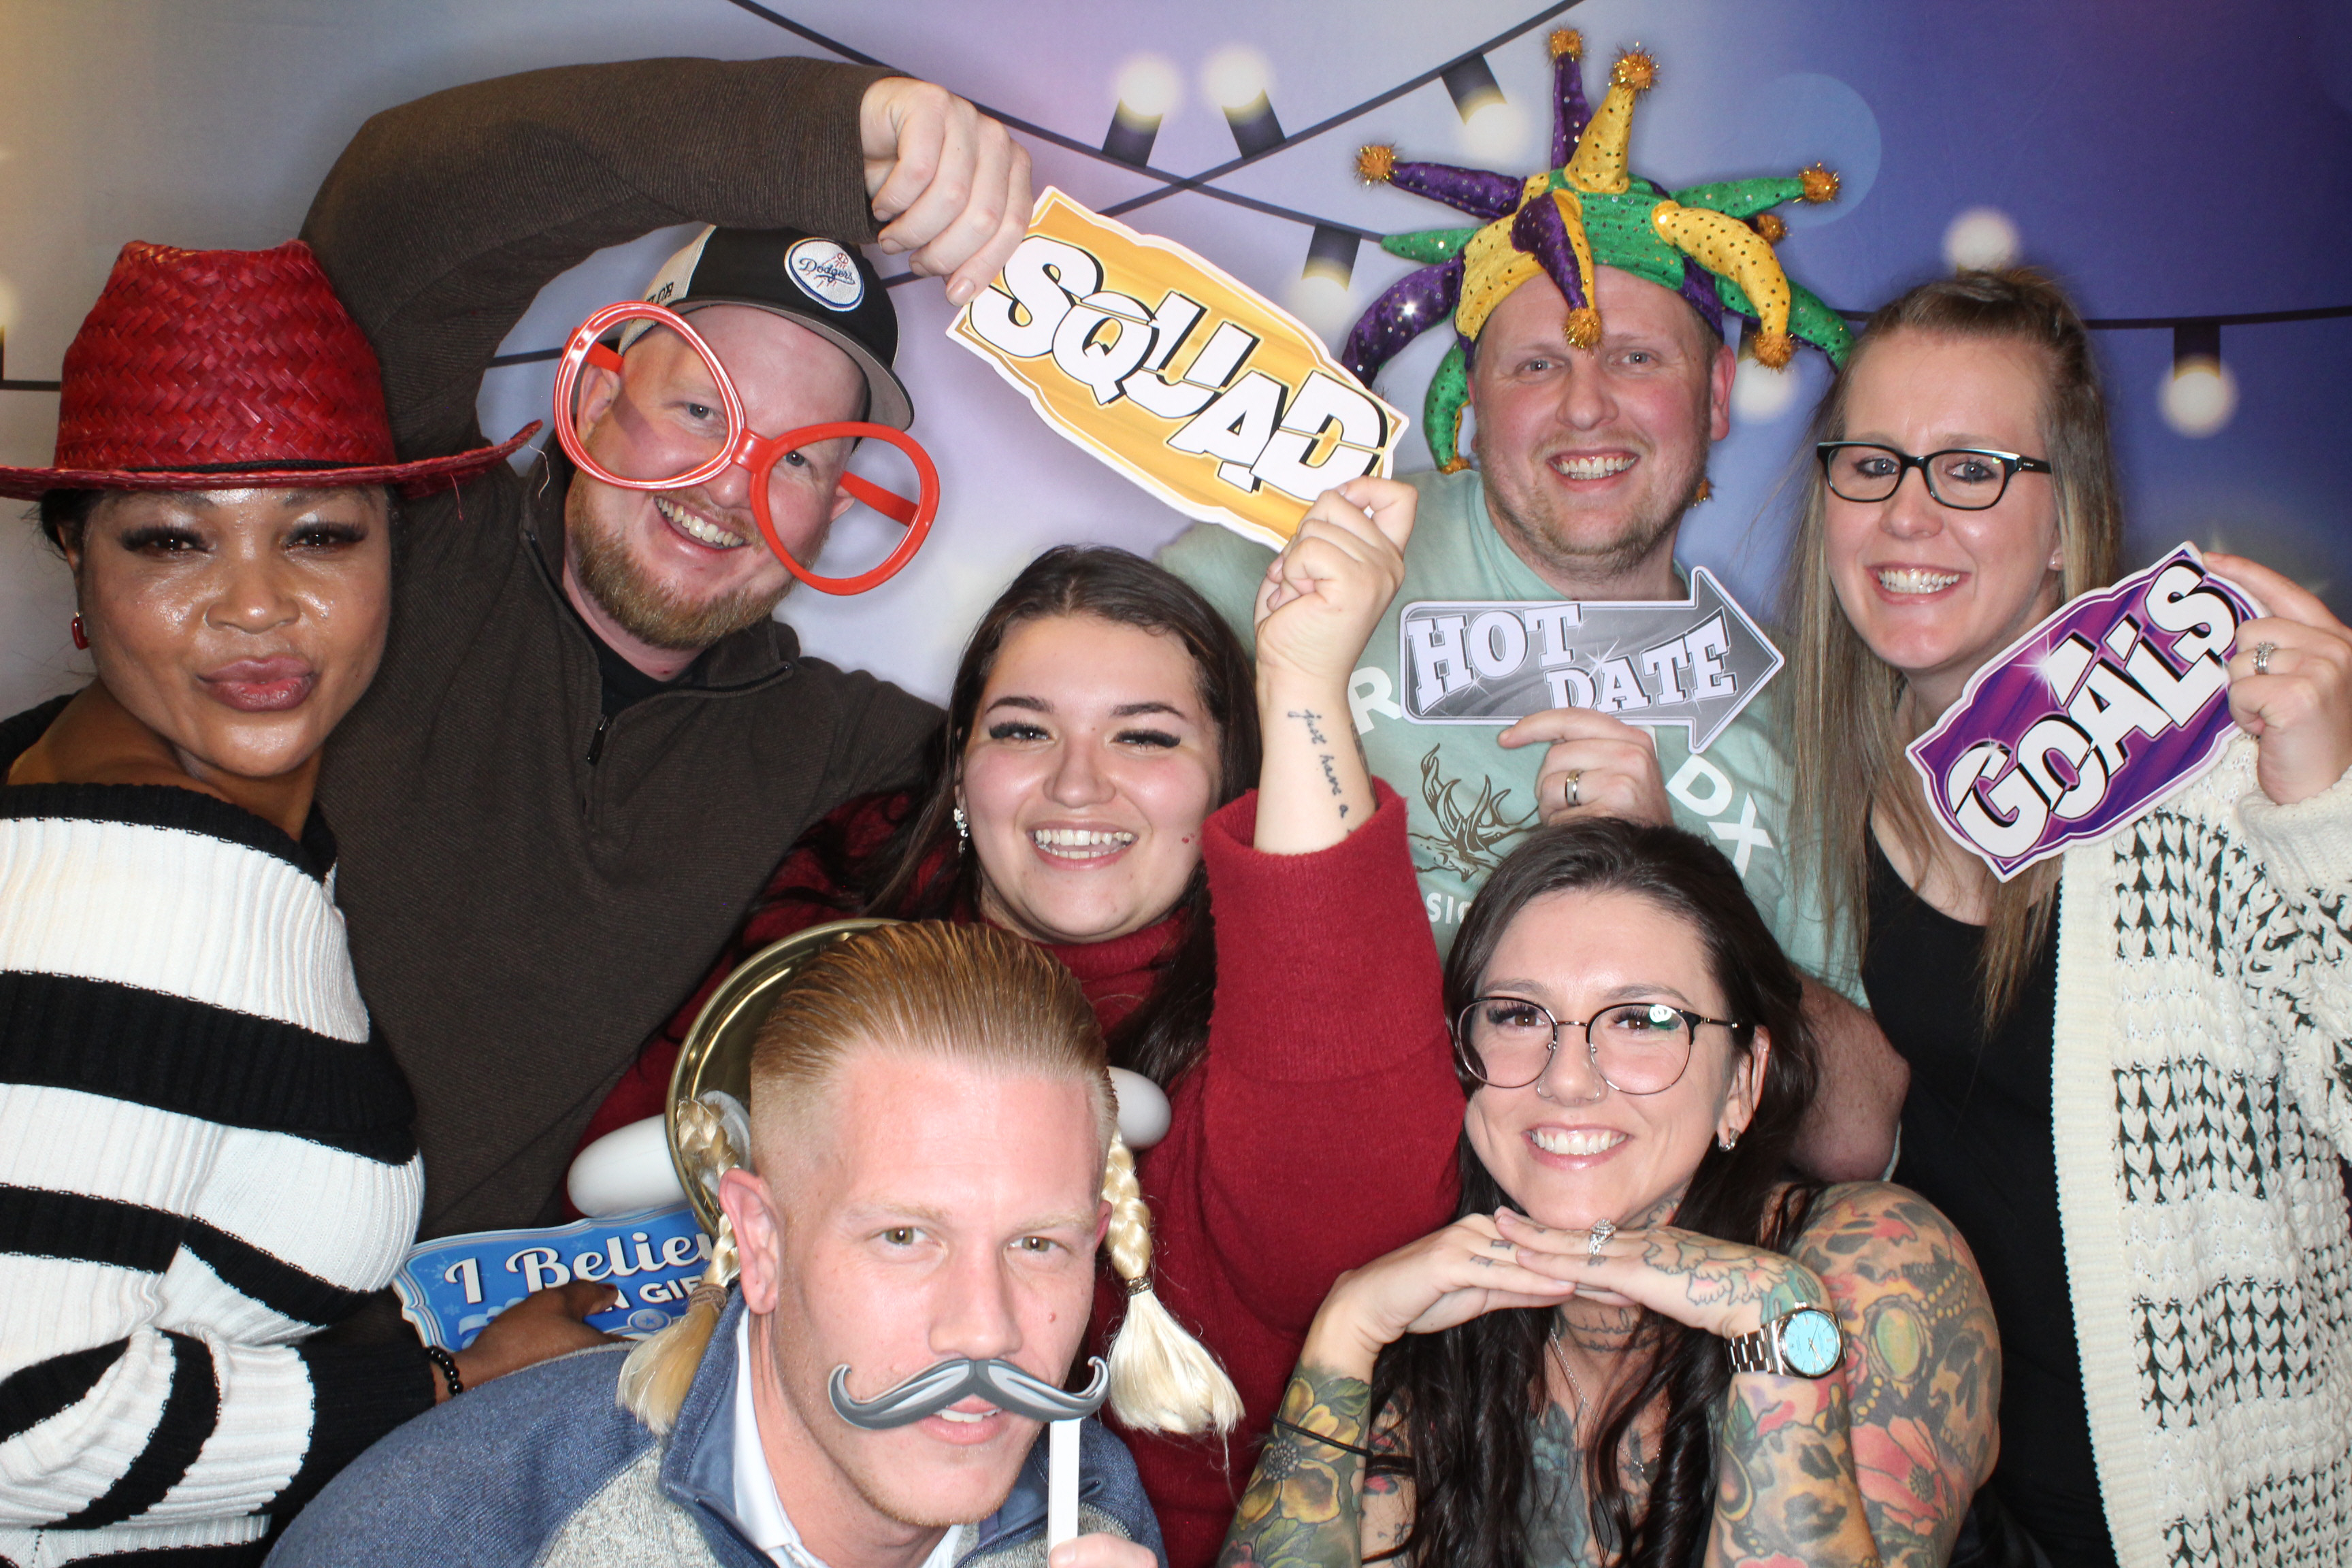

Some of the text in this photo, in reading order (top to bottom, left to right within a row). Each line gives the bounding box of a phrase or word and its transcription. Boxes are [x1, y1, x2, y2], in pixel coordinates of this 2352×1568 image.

[798, 257, 855, 284] Dodgers
[969, 235, 1390, 502] SQUAD
[1406, 603, 1582, 715] HOT
[1546, 607, 1737, 711] DATE
[1946, 558, 2237, 858] GOALS
[1287, 709, 1328, 745] just
[1319, 754, 1342, 796] have
[444, 1257, 483, 1305] I
